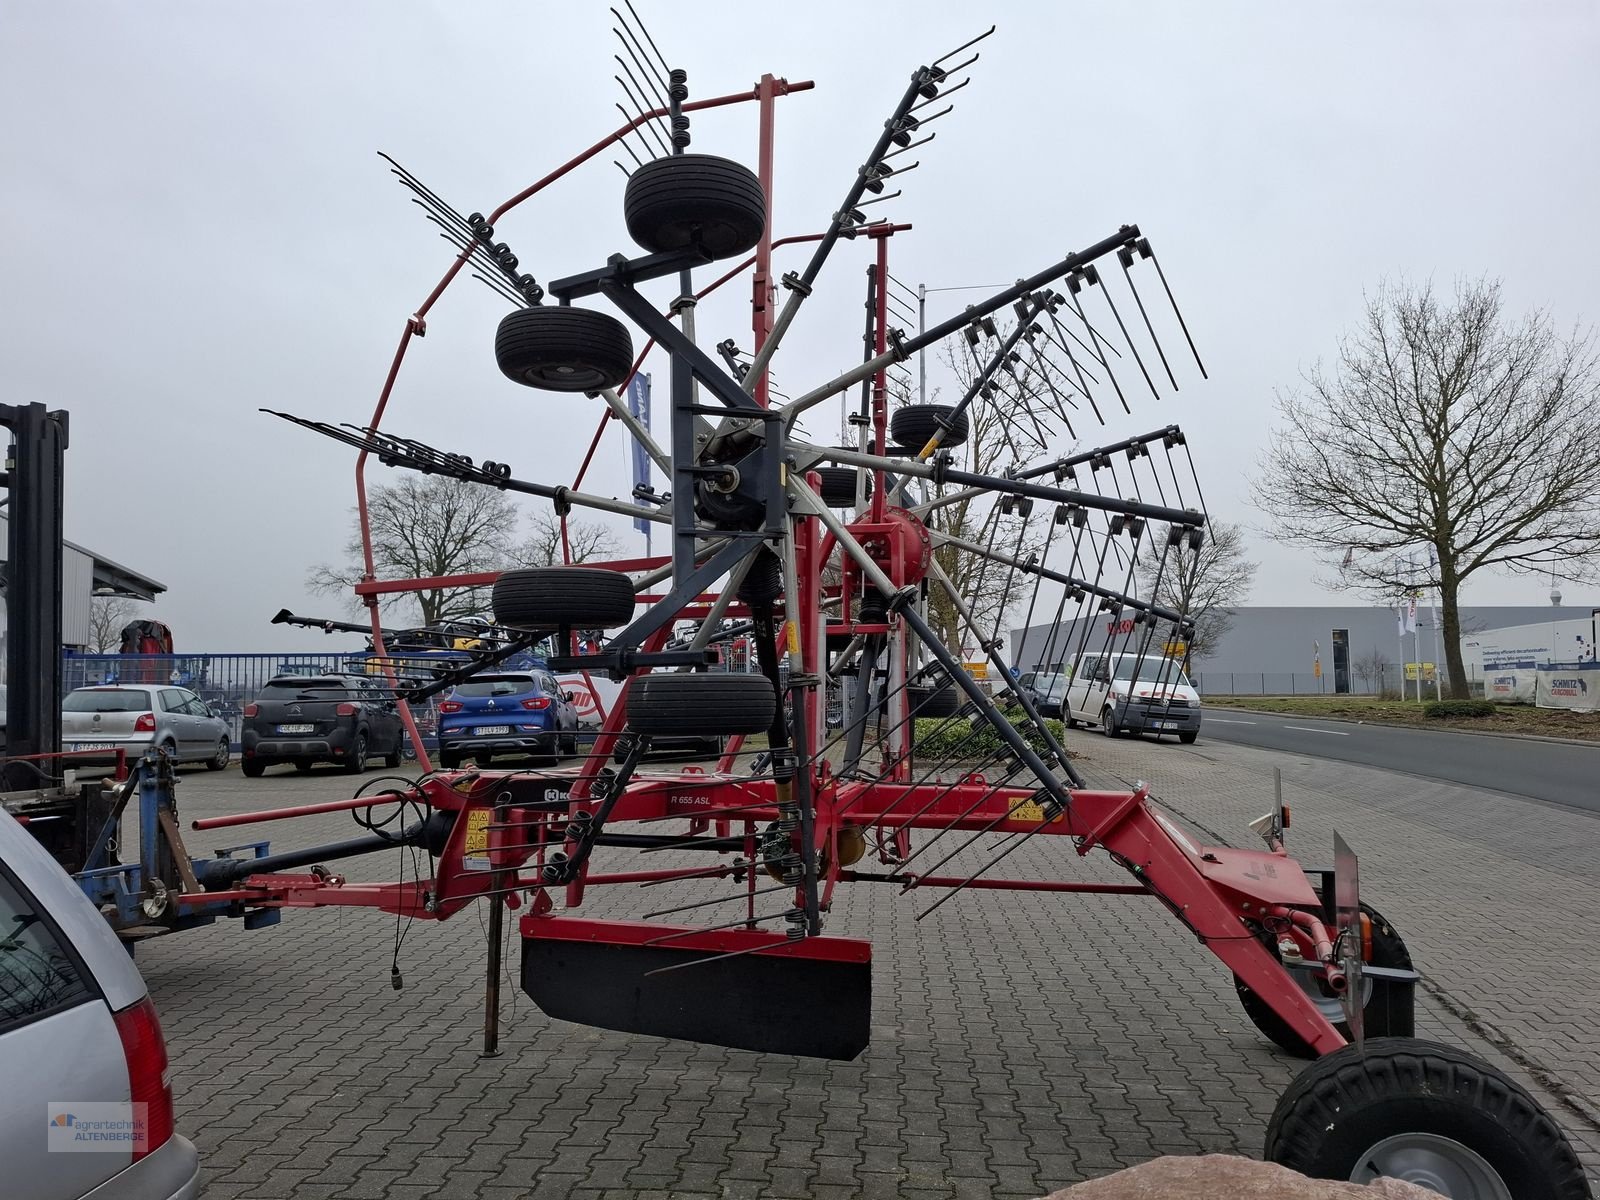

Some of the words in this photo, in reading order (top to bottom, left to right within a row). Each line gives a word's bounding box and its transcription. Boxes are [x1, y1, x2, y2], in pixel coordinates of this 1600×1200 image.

[1552, 679, 1577, 688] SCHMITZ
[1551, 688, 1578, 696] CARGOBULL
[671, 796, 678, 804] R
[679, 796, 693, 804] 655
[694, 796, 711, 805] ASL
